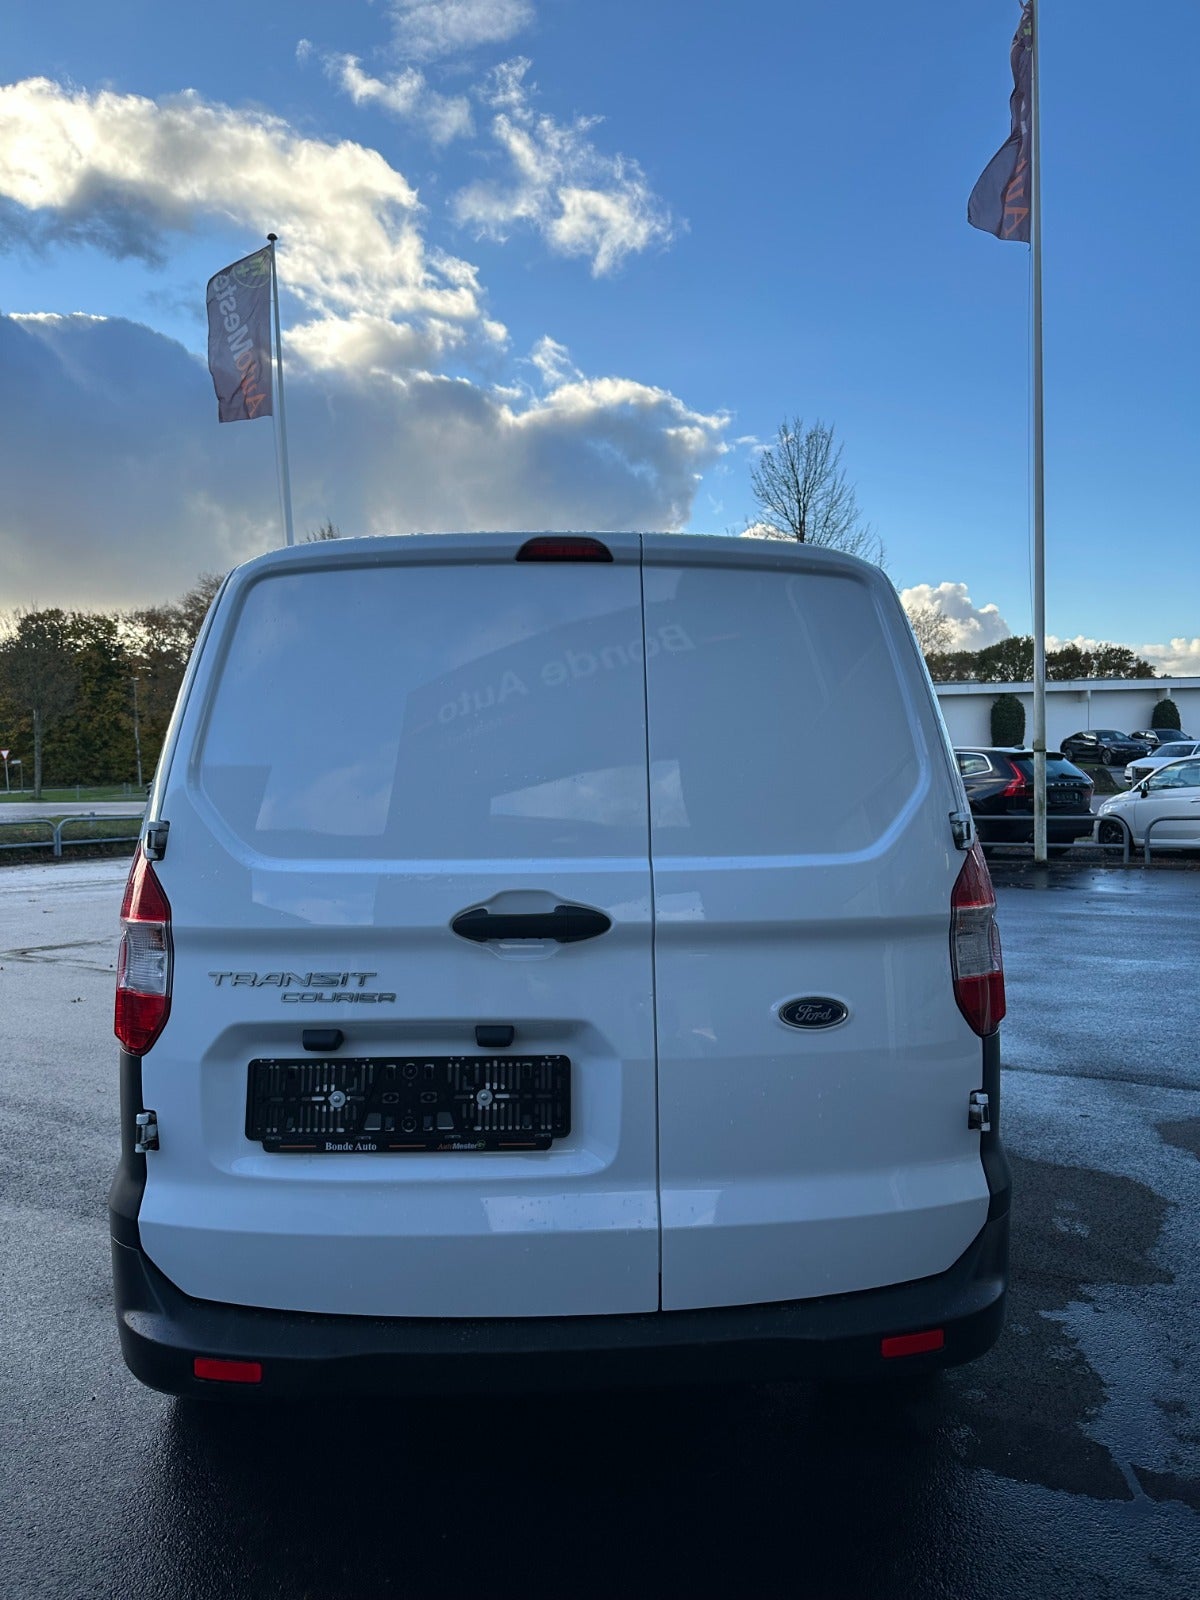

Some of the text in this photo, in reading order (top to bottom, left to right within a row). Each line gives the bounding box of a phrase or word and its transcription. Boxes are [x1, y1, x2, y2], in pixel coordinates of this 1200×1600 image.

[207, 971, 378, 987] TRANSIT
[280, 992, 397, 1003] COURIER
[795, 1004, 832, 1021] Ford
[325, 1142, 377, 1151] Bonde Auto
